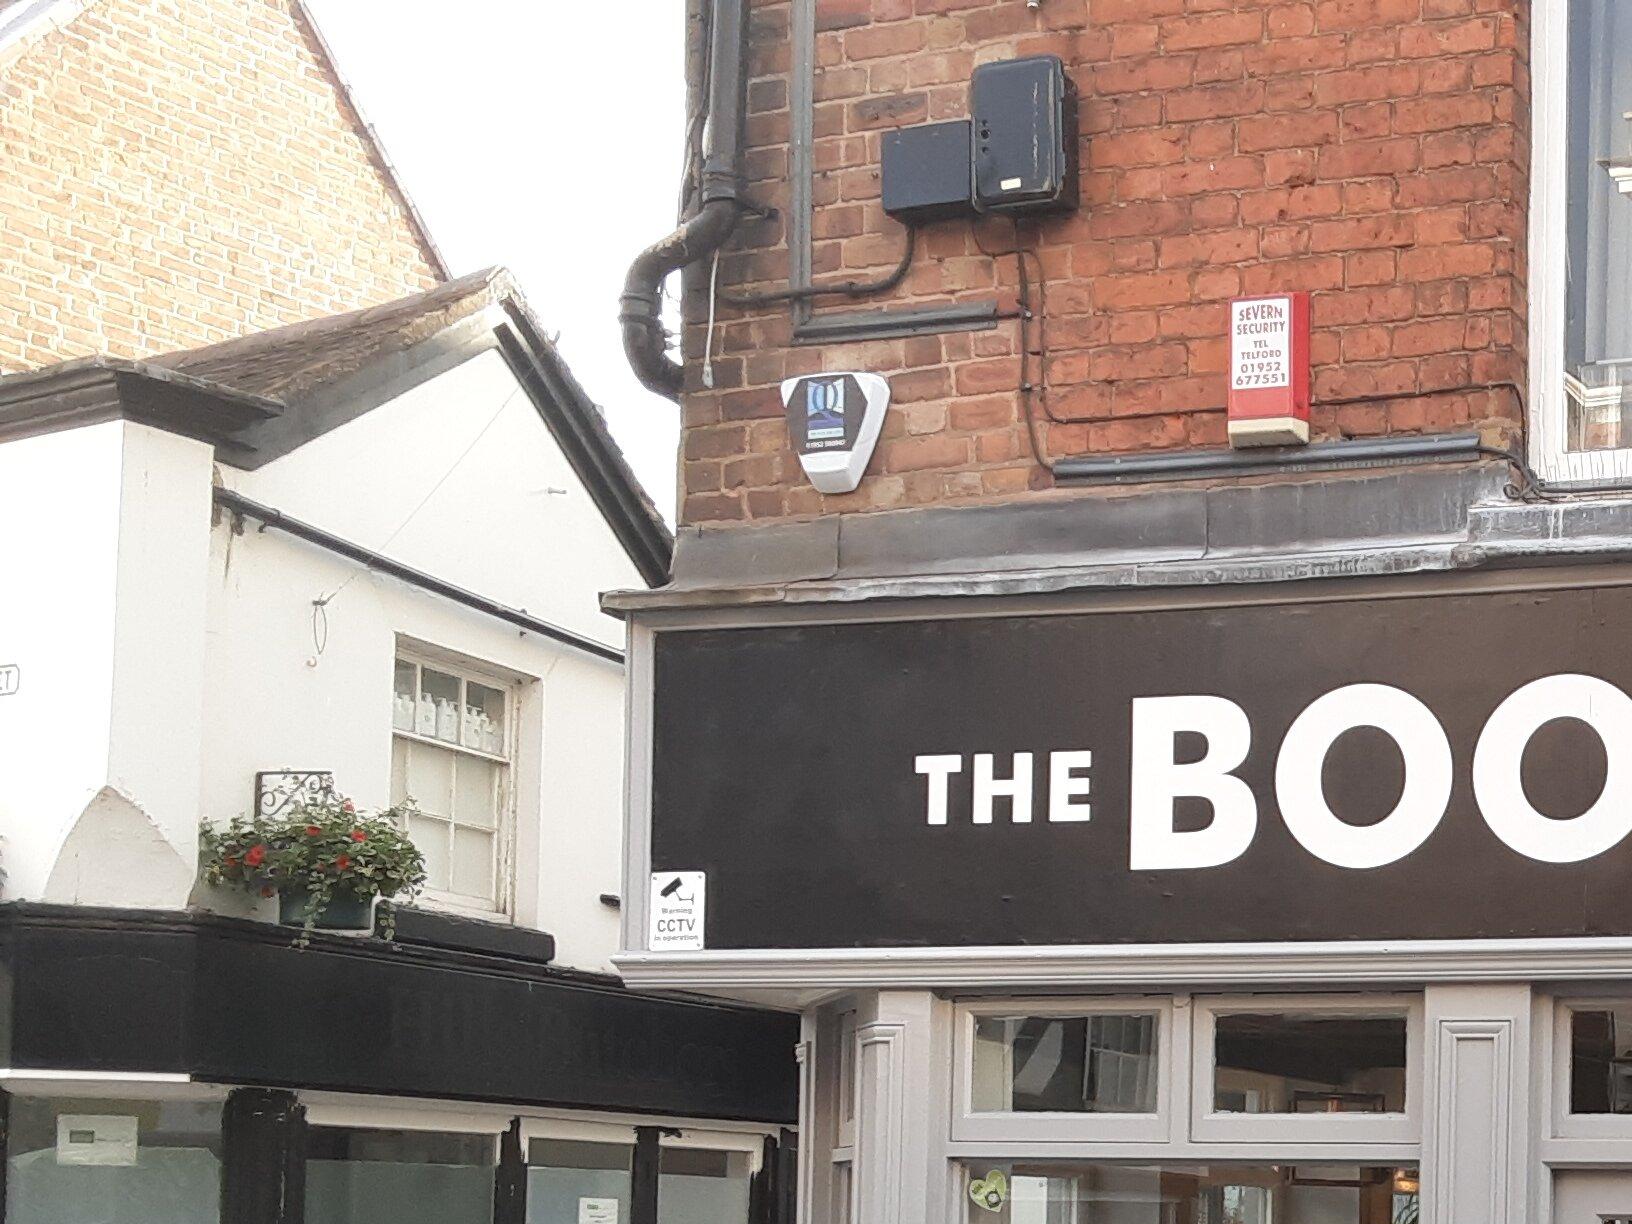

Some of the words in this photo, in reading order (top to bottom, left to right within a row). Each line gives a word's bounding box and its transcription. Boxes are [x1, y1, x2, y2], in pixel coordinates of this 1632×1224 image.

[1239, 304, 1283, 321] SEVERN
[1237, 321, 1286, 335] SECURITY
[1253, 340, 1268, 348] TEL
[1241, 350, 1282, 360] TELFORD
[1240, 362, 1281, 373] 01952
[1236, 373, 1286, 385] 677551
[915, 750, 1093, 826] THE
[658, 918, 696, 932] CCTV
